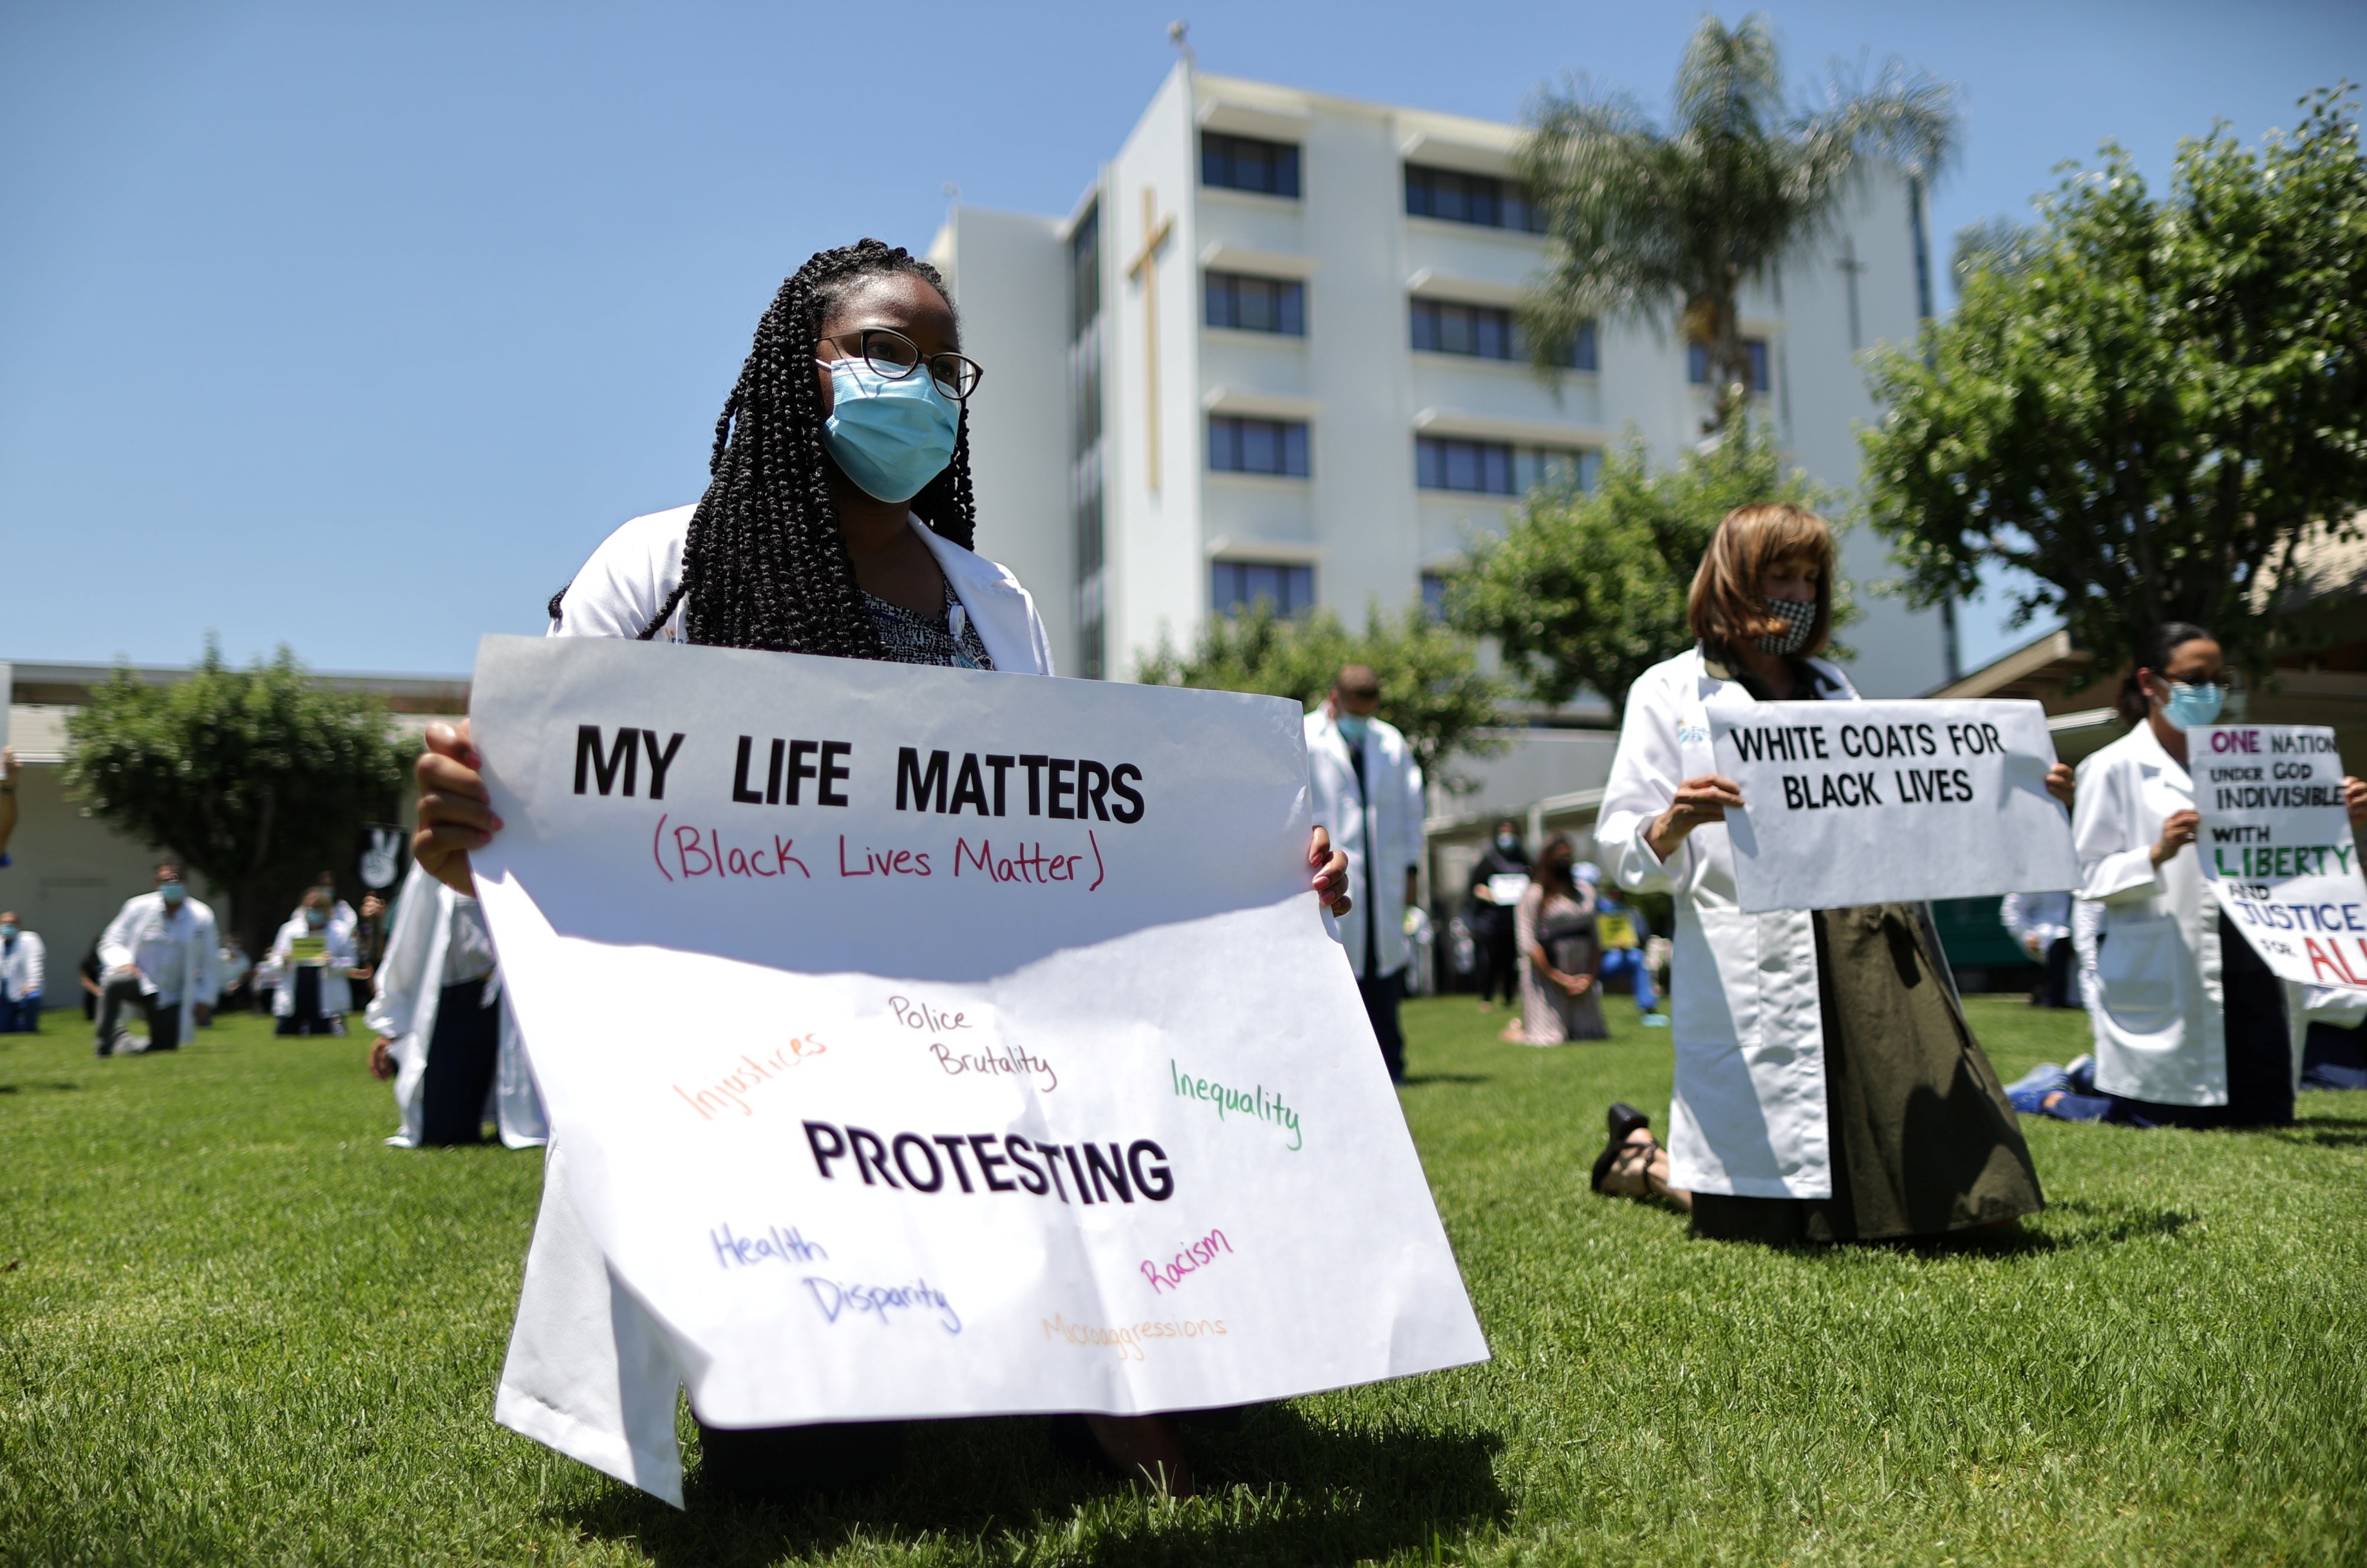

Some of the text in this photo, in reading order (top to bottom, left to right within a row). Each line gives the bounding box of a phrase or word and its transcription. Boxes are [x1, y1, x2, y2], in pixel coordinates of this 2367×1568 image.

[1729, 725, 1829, 762] WHITE
[1840, 723, 1937, 758] COATS
[1946, 723, 2008, 756] FOR
[2211, 731, 2337, 753] ONE NATION
[574, 725, 1144, 824] MY LIFE MATTERS
[1782, 769, 1973, 810] BLACK LIVES
[2210, 762, 2313, 782] UNDER GOD
[2217, 786, 2345, 809] INDIVISIBLE
[654, 814, 1104, 891] (Black Lives Matter)
[2212, 826, 2269, 842] WITH
[2215, 846, 2353, 876] LIBERTY
[2229, 885, 2269, 899] AND
[2234, 902, 2366, 930] JUSTICE
[888, 996, 972, 1032] Police
[672, 1031, 827, 1121] Injustices
[930, 1044, 1057, 1092] Brutality
[1171, 1059, 1302, 1151] Inequality
[802, 1119, 1175, 1205] PROTESTING
[710, 1222, 828, 1269] Health
[1140, 1228, 1234, 1295] Racism
[801, 1276, 962, 1335] Disparity
[1043, 1313, 1228, 1361] Microaggressions
